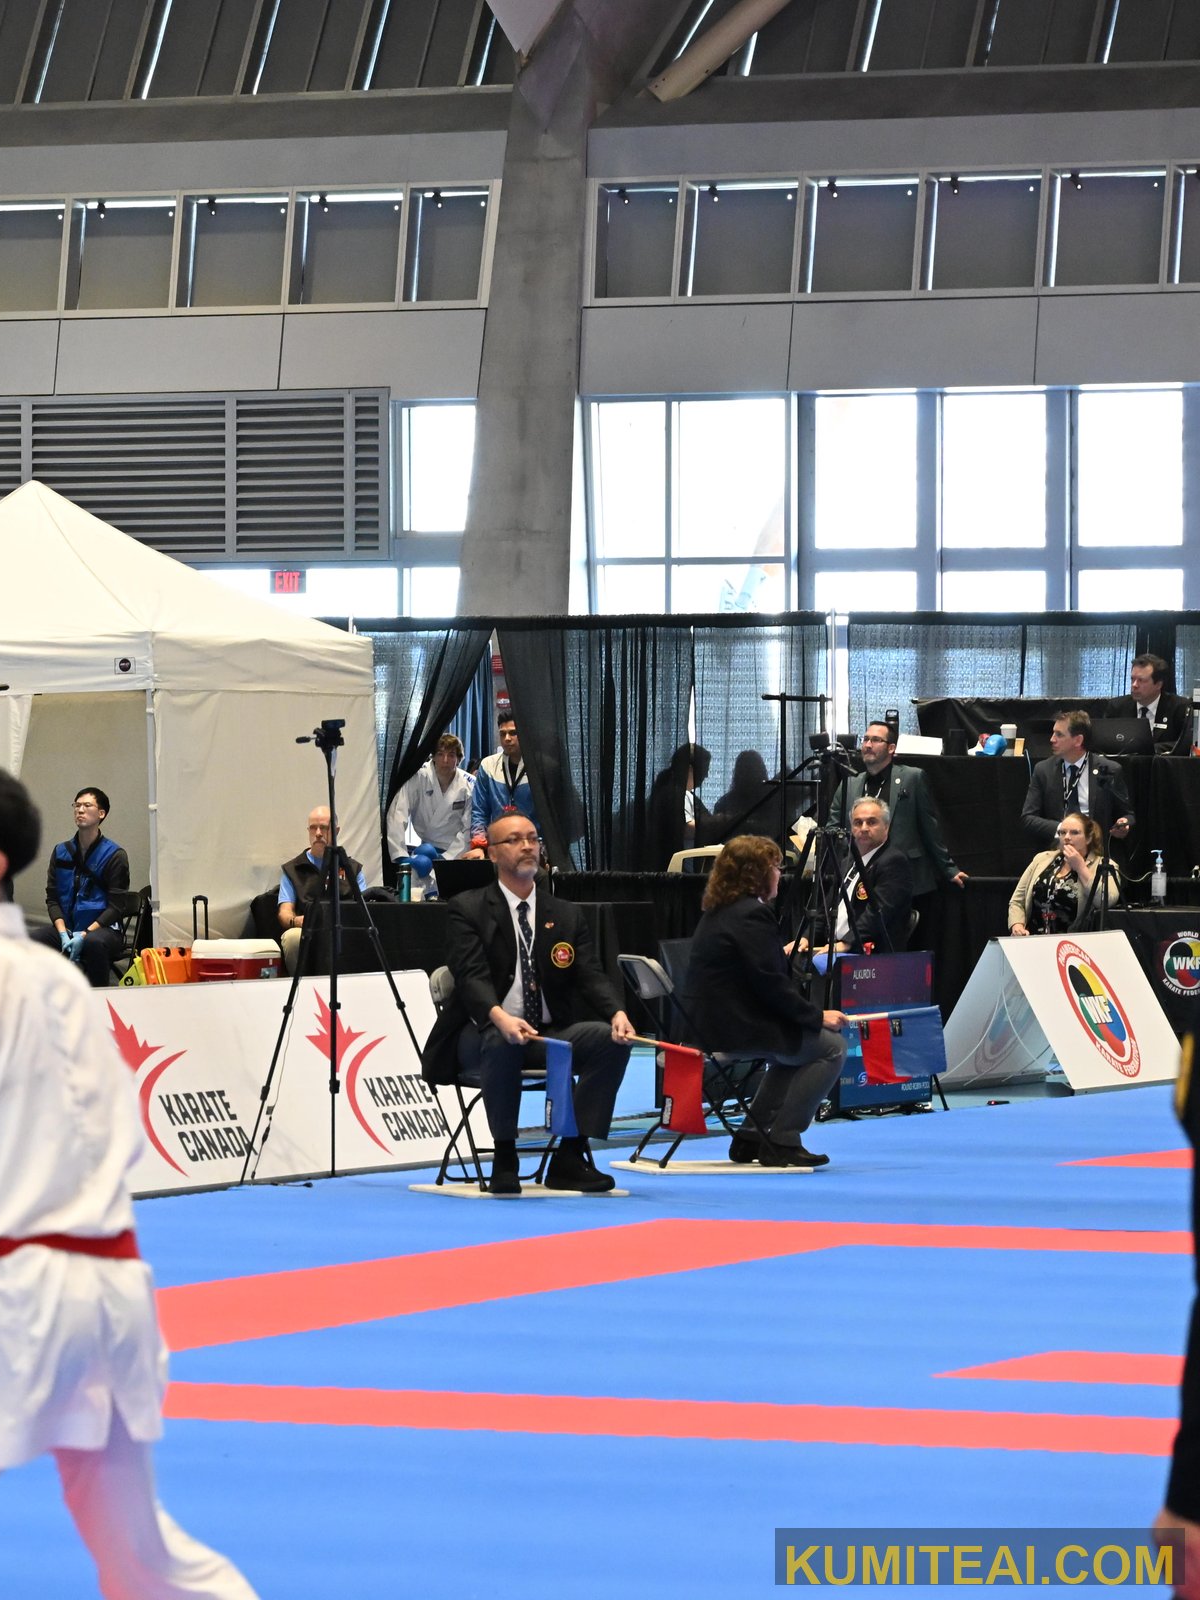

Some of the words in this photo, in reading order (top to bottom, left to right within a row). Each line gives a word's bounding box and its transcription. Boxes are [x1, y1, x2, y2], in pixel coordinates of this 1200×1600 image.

[275, 571, 301, 593] EXIT
[1177, 930, 1199, 938] WORLD
[1162, 978, 1182, 995] KARATE
[1080, 995, 1113, 1024] WKF
[362, 1074, 433, 1108] KARATE
[158, 1090, 238, 1126] KARATE
[381, 1108, 448, 1141] CANADA
[177, 1126, 258, 1162] CANADA
